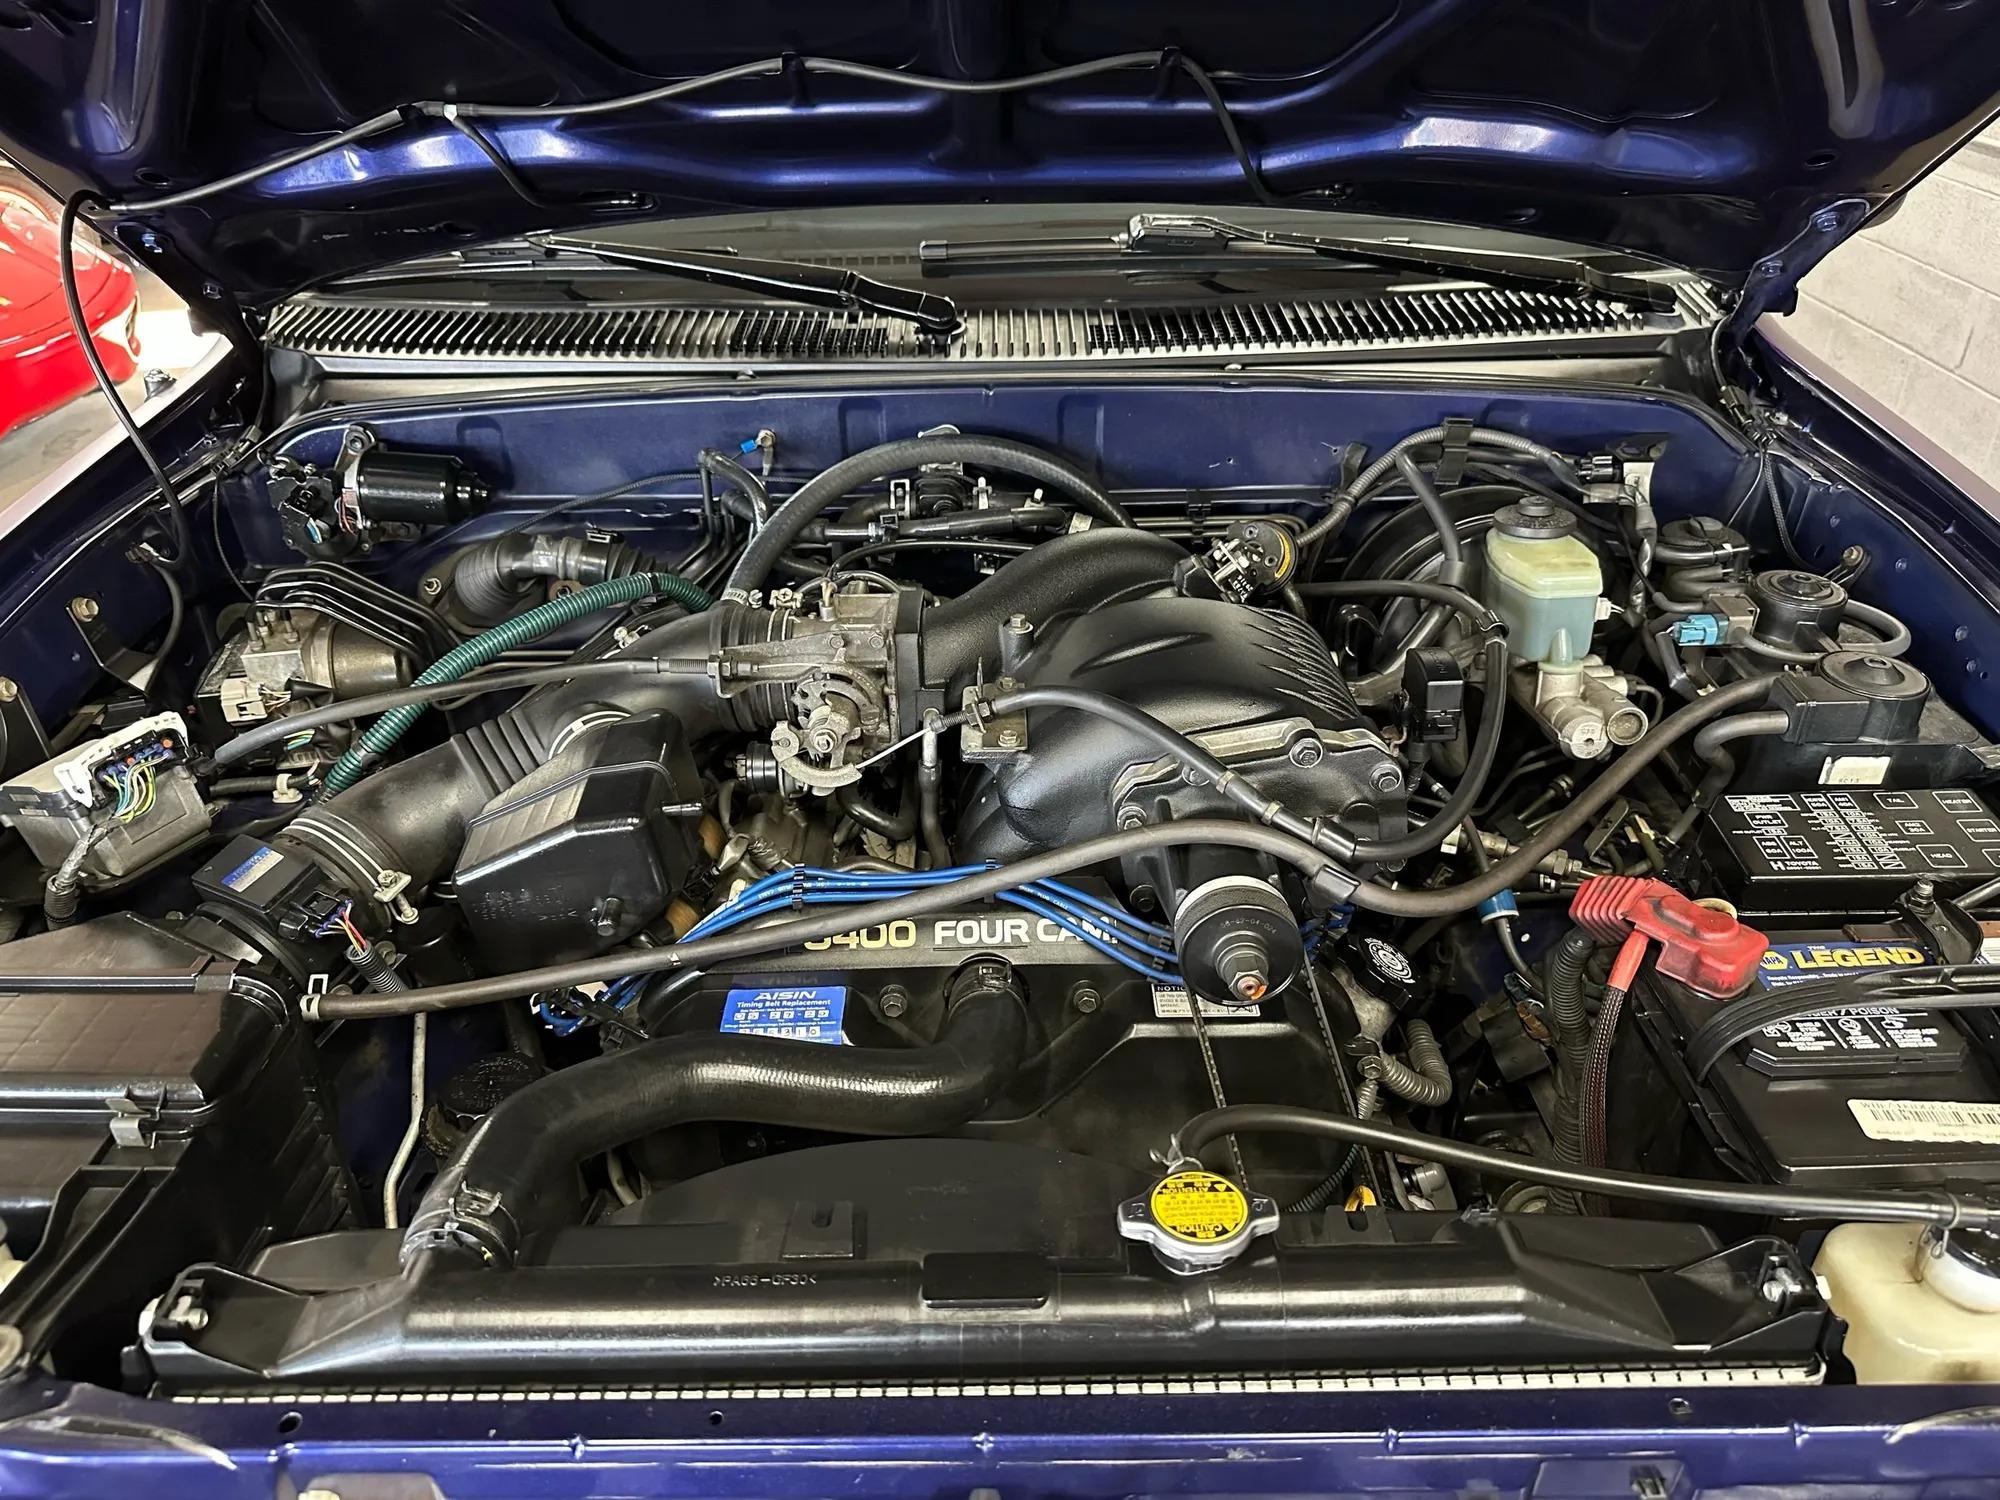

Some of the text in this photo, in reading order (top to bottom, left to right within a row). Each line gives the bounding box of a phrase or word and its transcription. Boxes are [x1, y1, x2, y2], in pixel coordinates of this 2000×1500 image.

[933, 918, 1029, 945] FOUR
[1792, 947, 1924, 969] LEGEND
[754, 990, 817, 1001] AISIN
[782, 999, 831, 1007] Replacement
[1176, 1224, 1223, 1233] CAUTION
